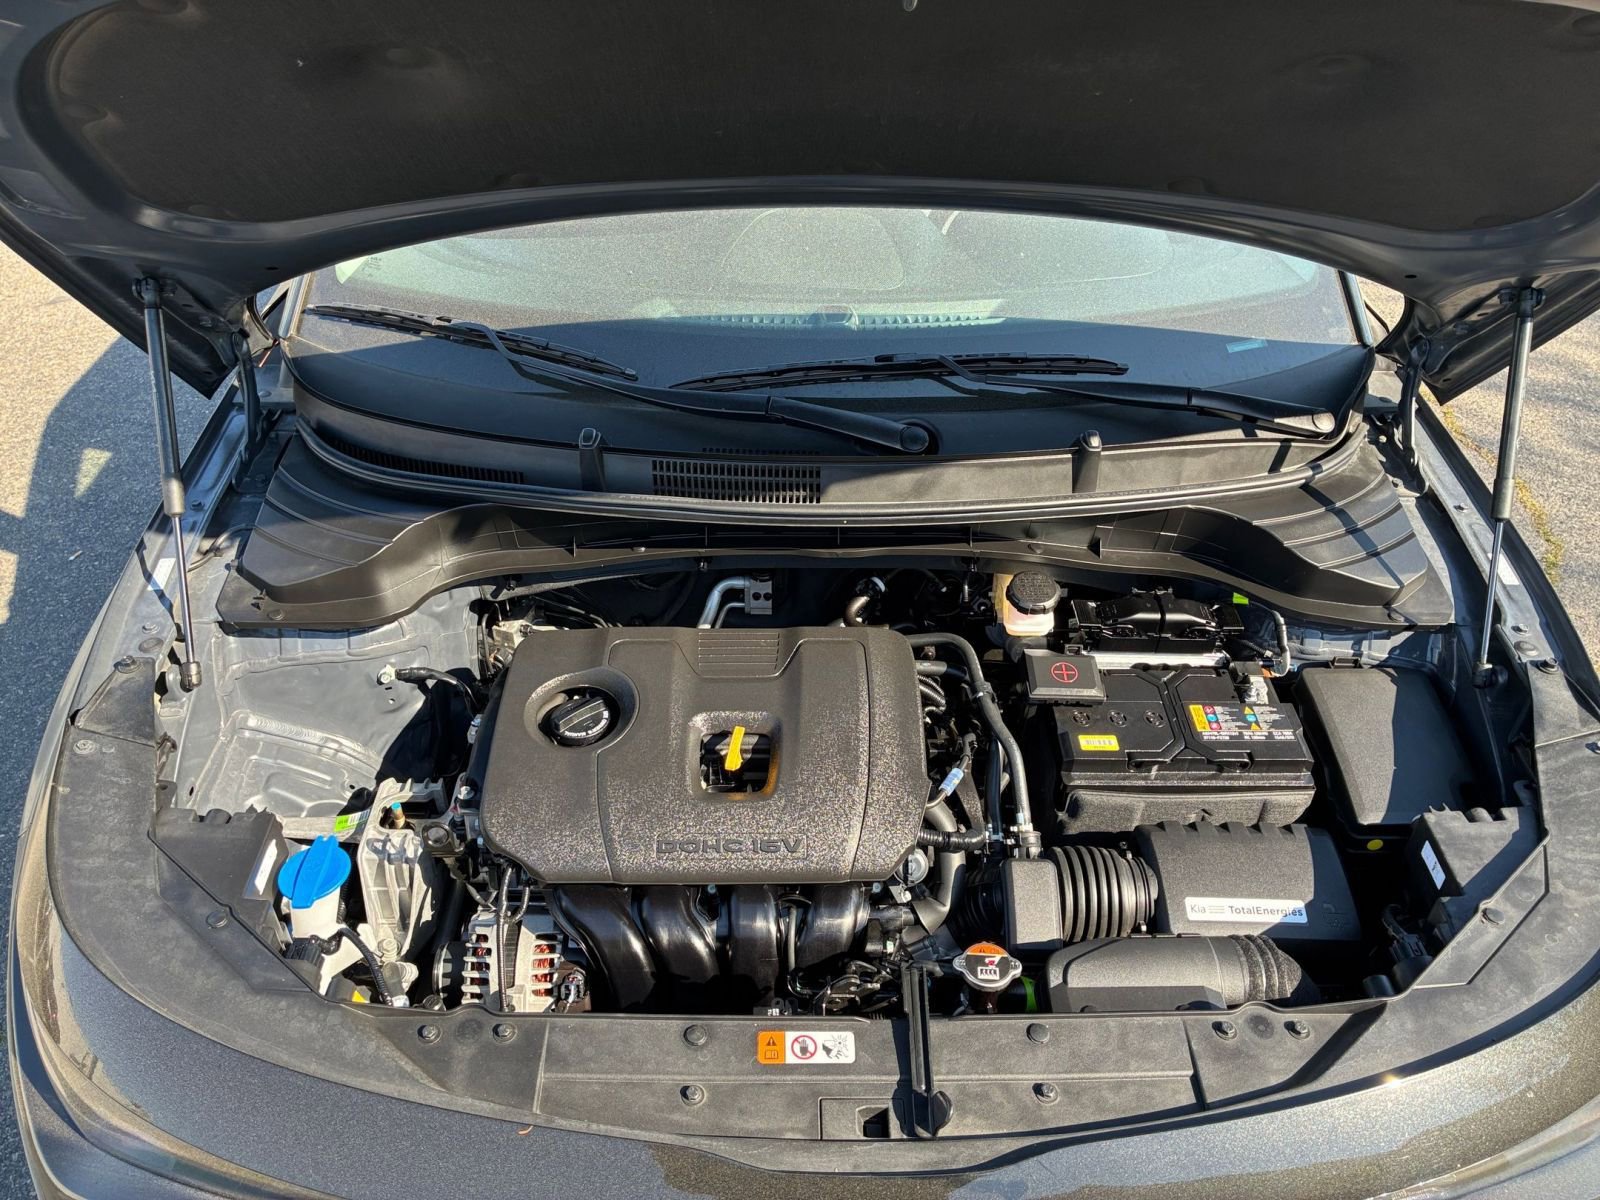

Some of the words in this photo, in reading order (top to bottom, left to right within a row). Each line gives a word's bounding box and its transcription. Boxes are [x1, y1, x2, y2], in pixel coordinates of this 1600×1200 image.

[657, 839, 744, 854] DOHC
[752, 838, 799, 854] 16V
[1190, 904, 1207, 914] Kia
[1228, 905, 1304, 918] TotalEnergies
